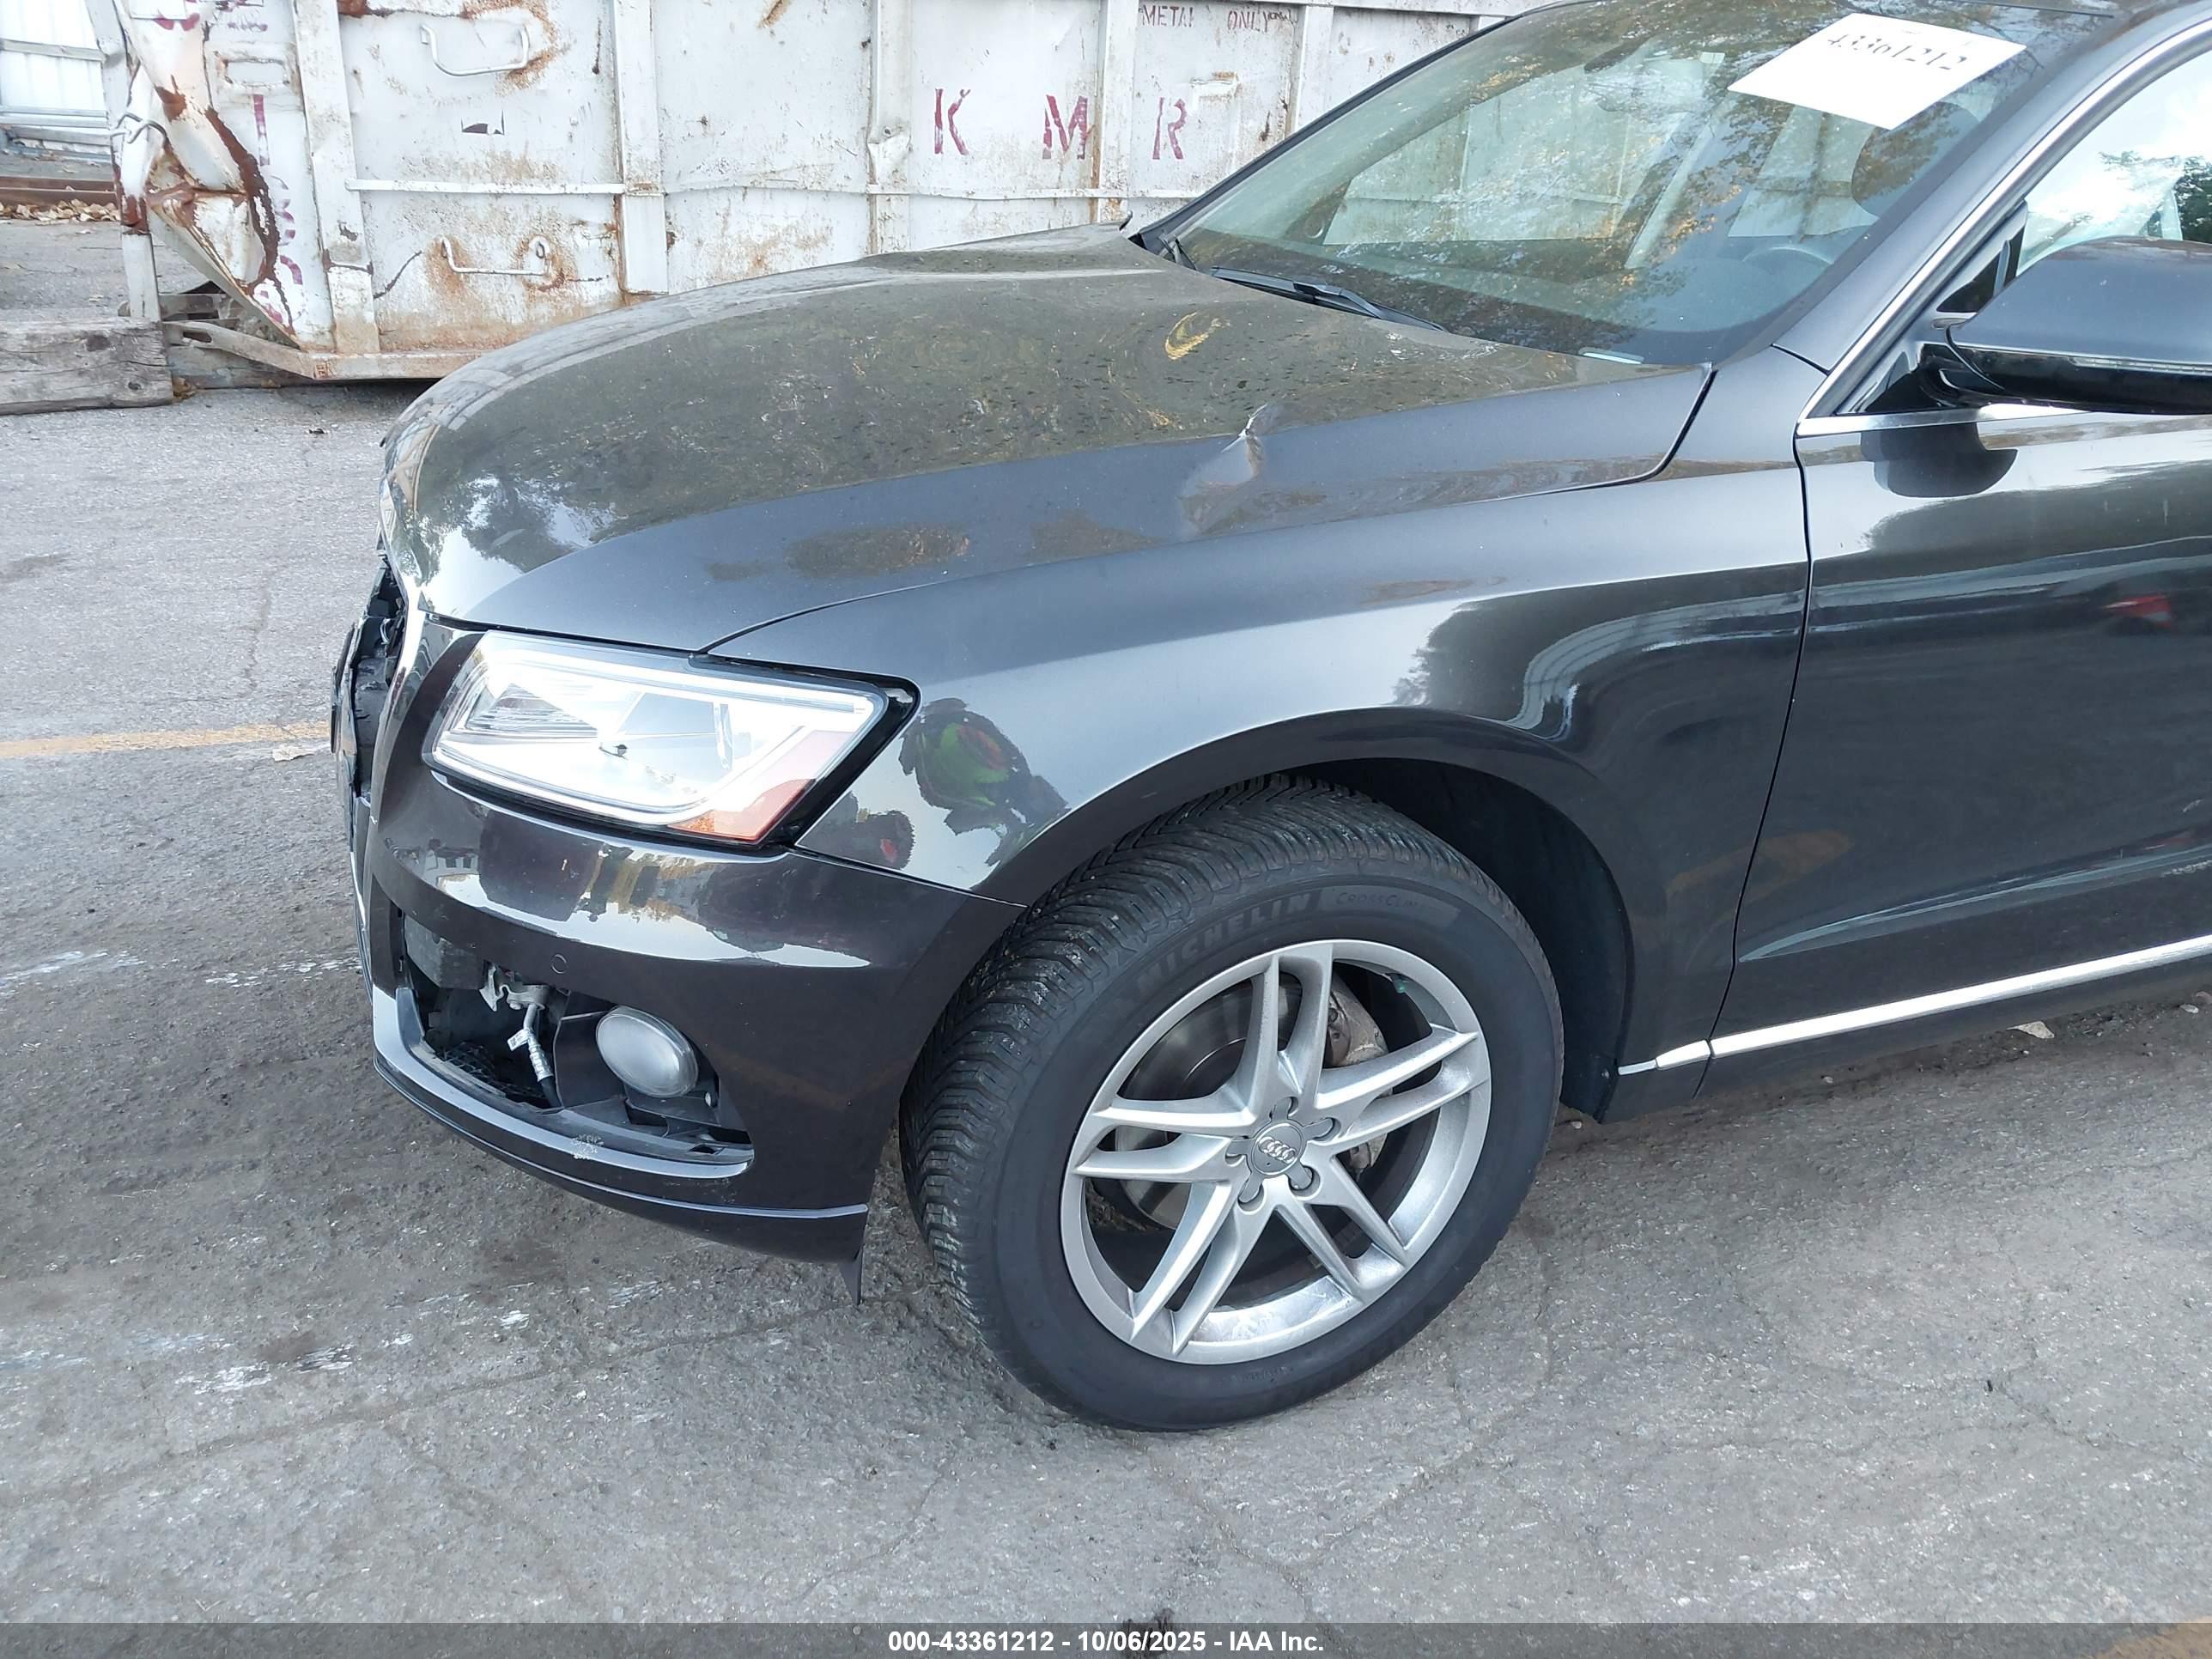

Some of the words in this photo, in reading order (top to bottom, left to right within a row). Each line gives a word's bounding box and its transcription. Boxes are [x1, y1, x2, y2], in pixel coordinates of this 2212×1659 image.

[1228, 10, 1268, 33] ONLY
[934, 88, 970, 155] K
[1042, 94, 1089, 159] M
[1152, 96, 1186, 159] R
[1137, 891, 1314, 992] MICHELIN
